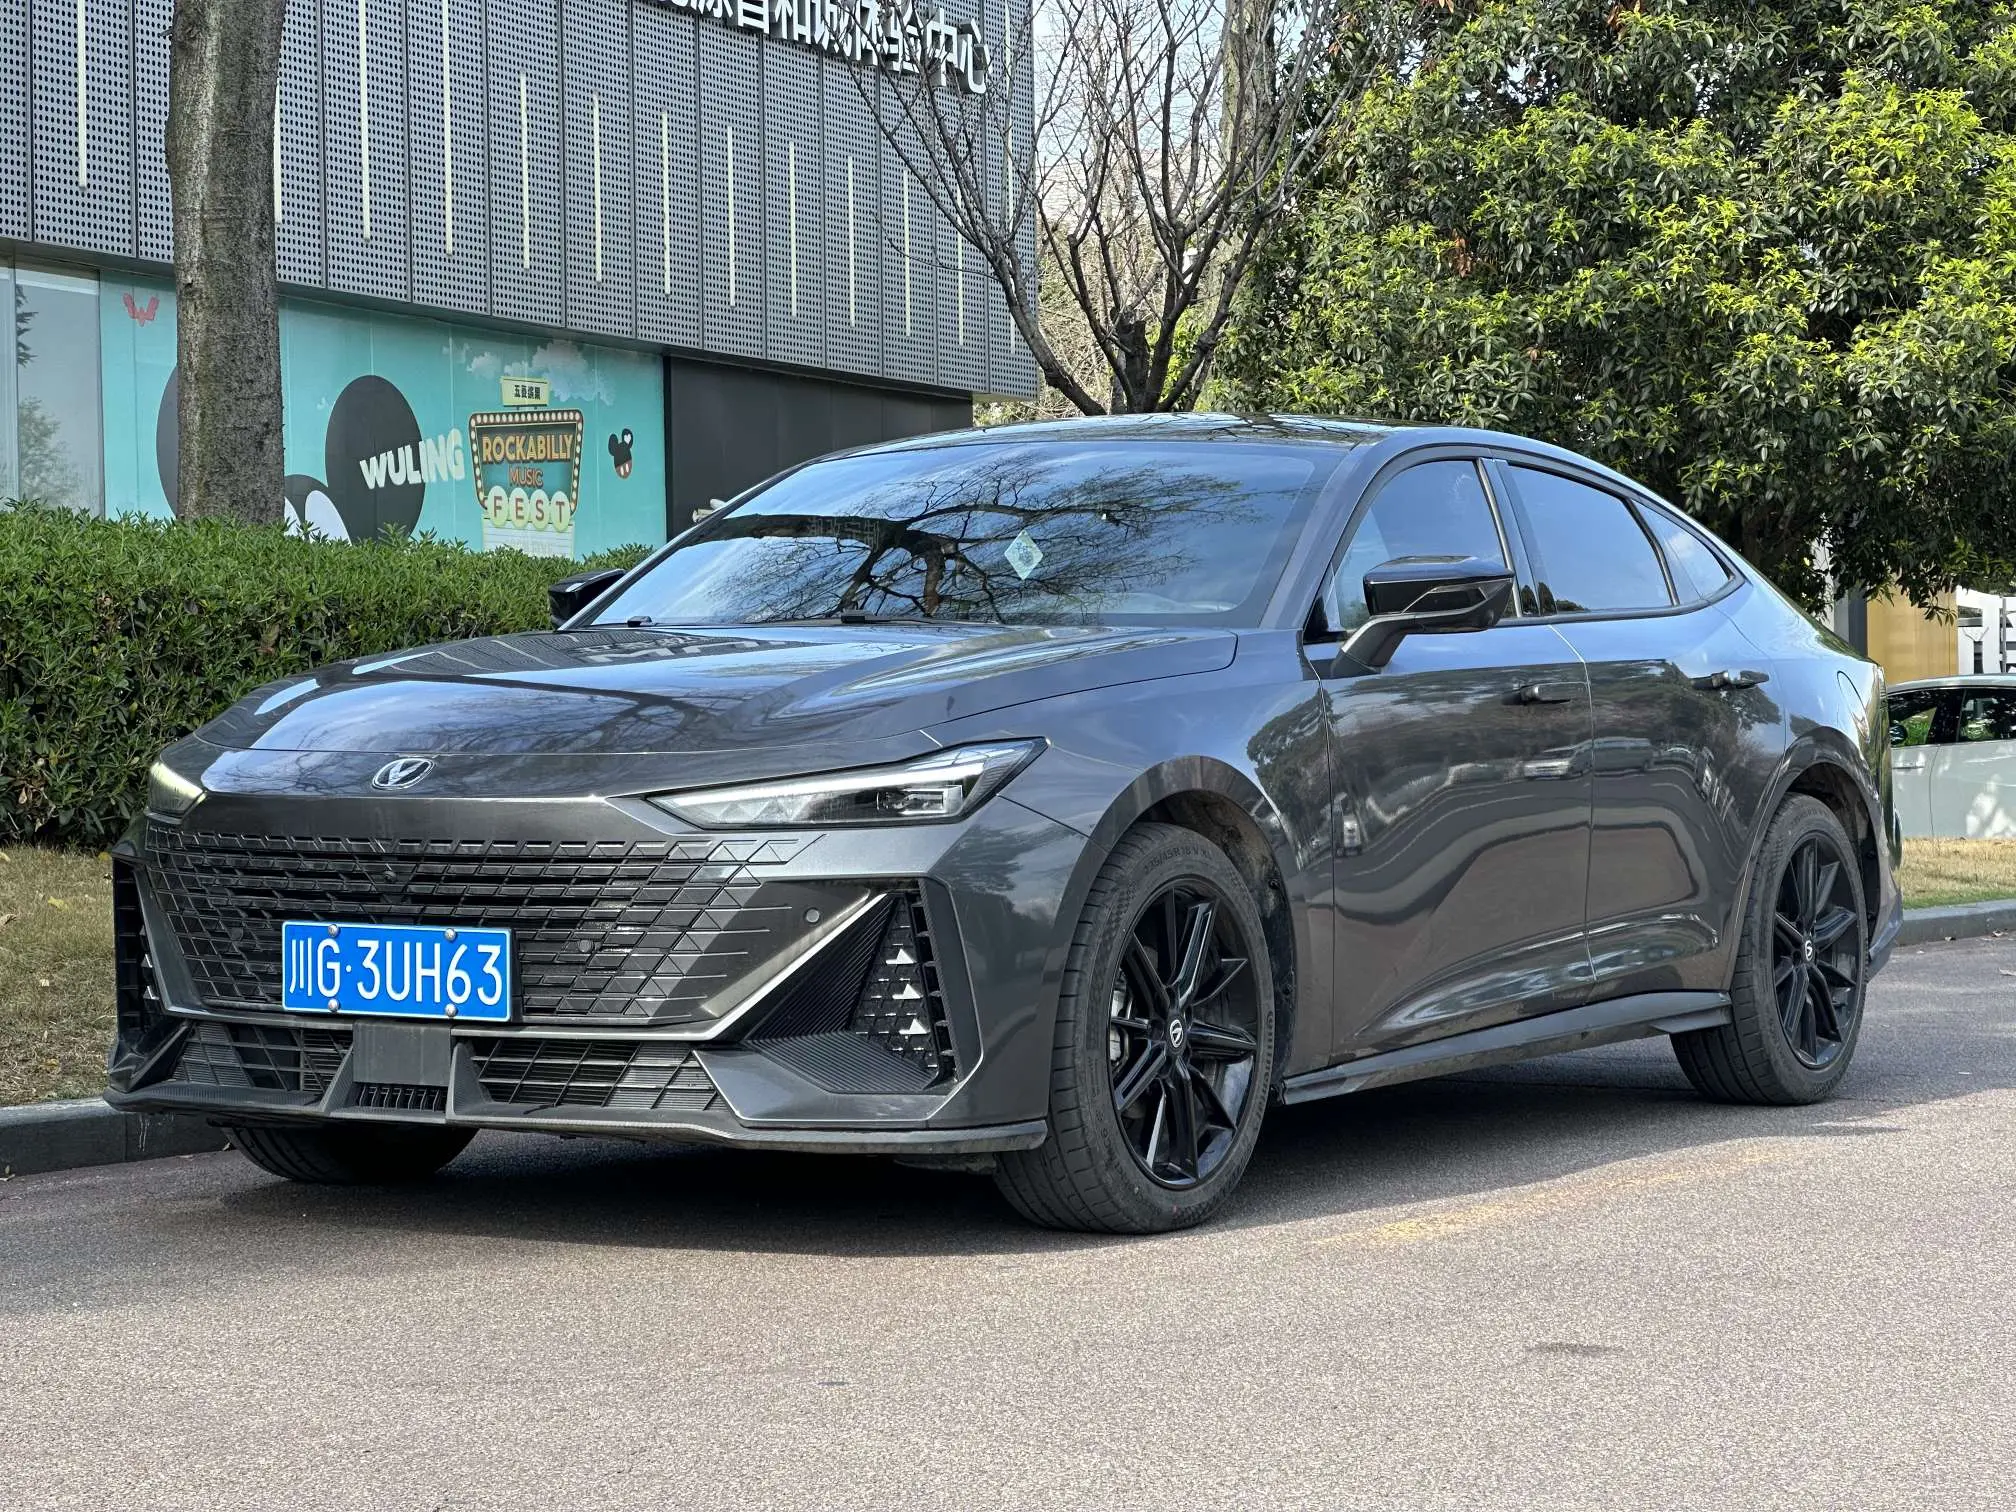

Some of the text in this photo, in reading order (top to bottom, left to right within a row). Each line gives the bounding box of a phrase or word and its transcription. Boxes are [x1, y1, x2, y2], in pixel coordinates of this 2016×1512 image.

[359, 428, 465, 490] WULING
[482, 432, 574, 464] ROCKABILLY
[508, 466, 544, 488] MUSIC
[493, 495, 566, 523] FEST
[289, 937, 503, 1006] 川G·3UH63
